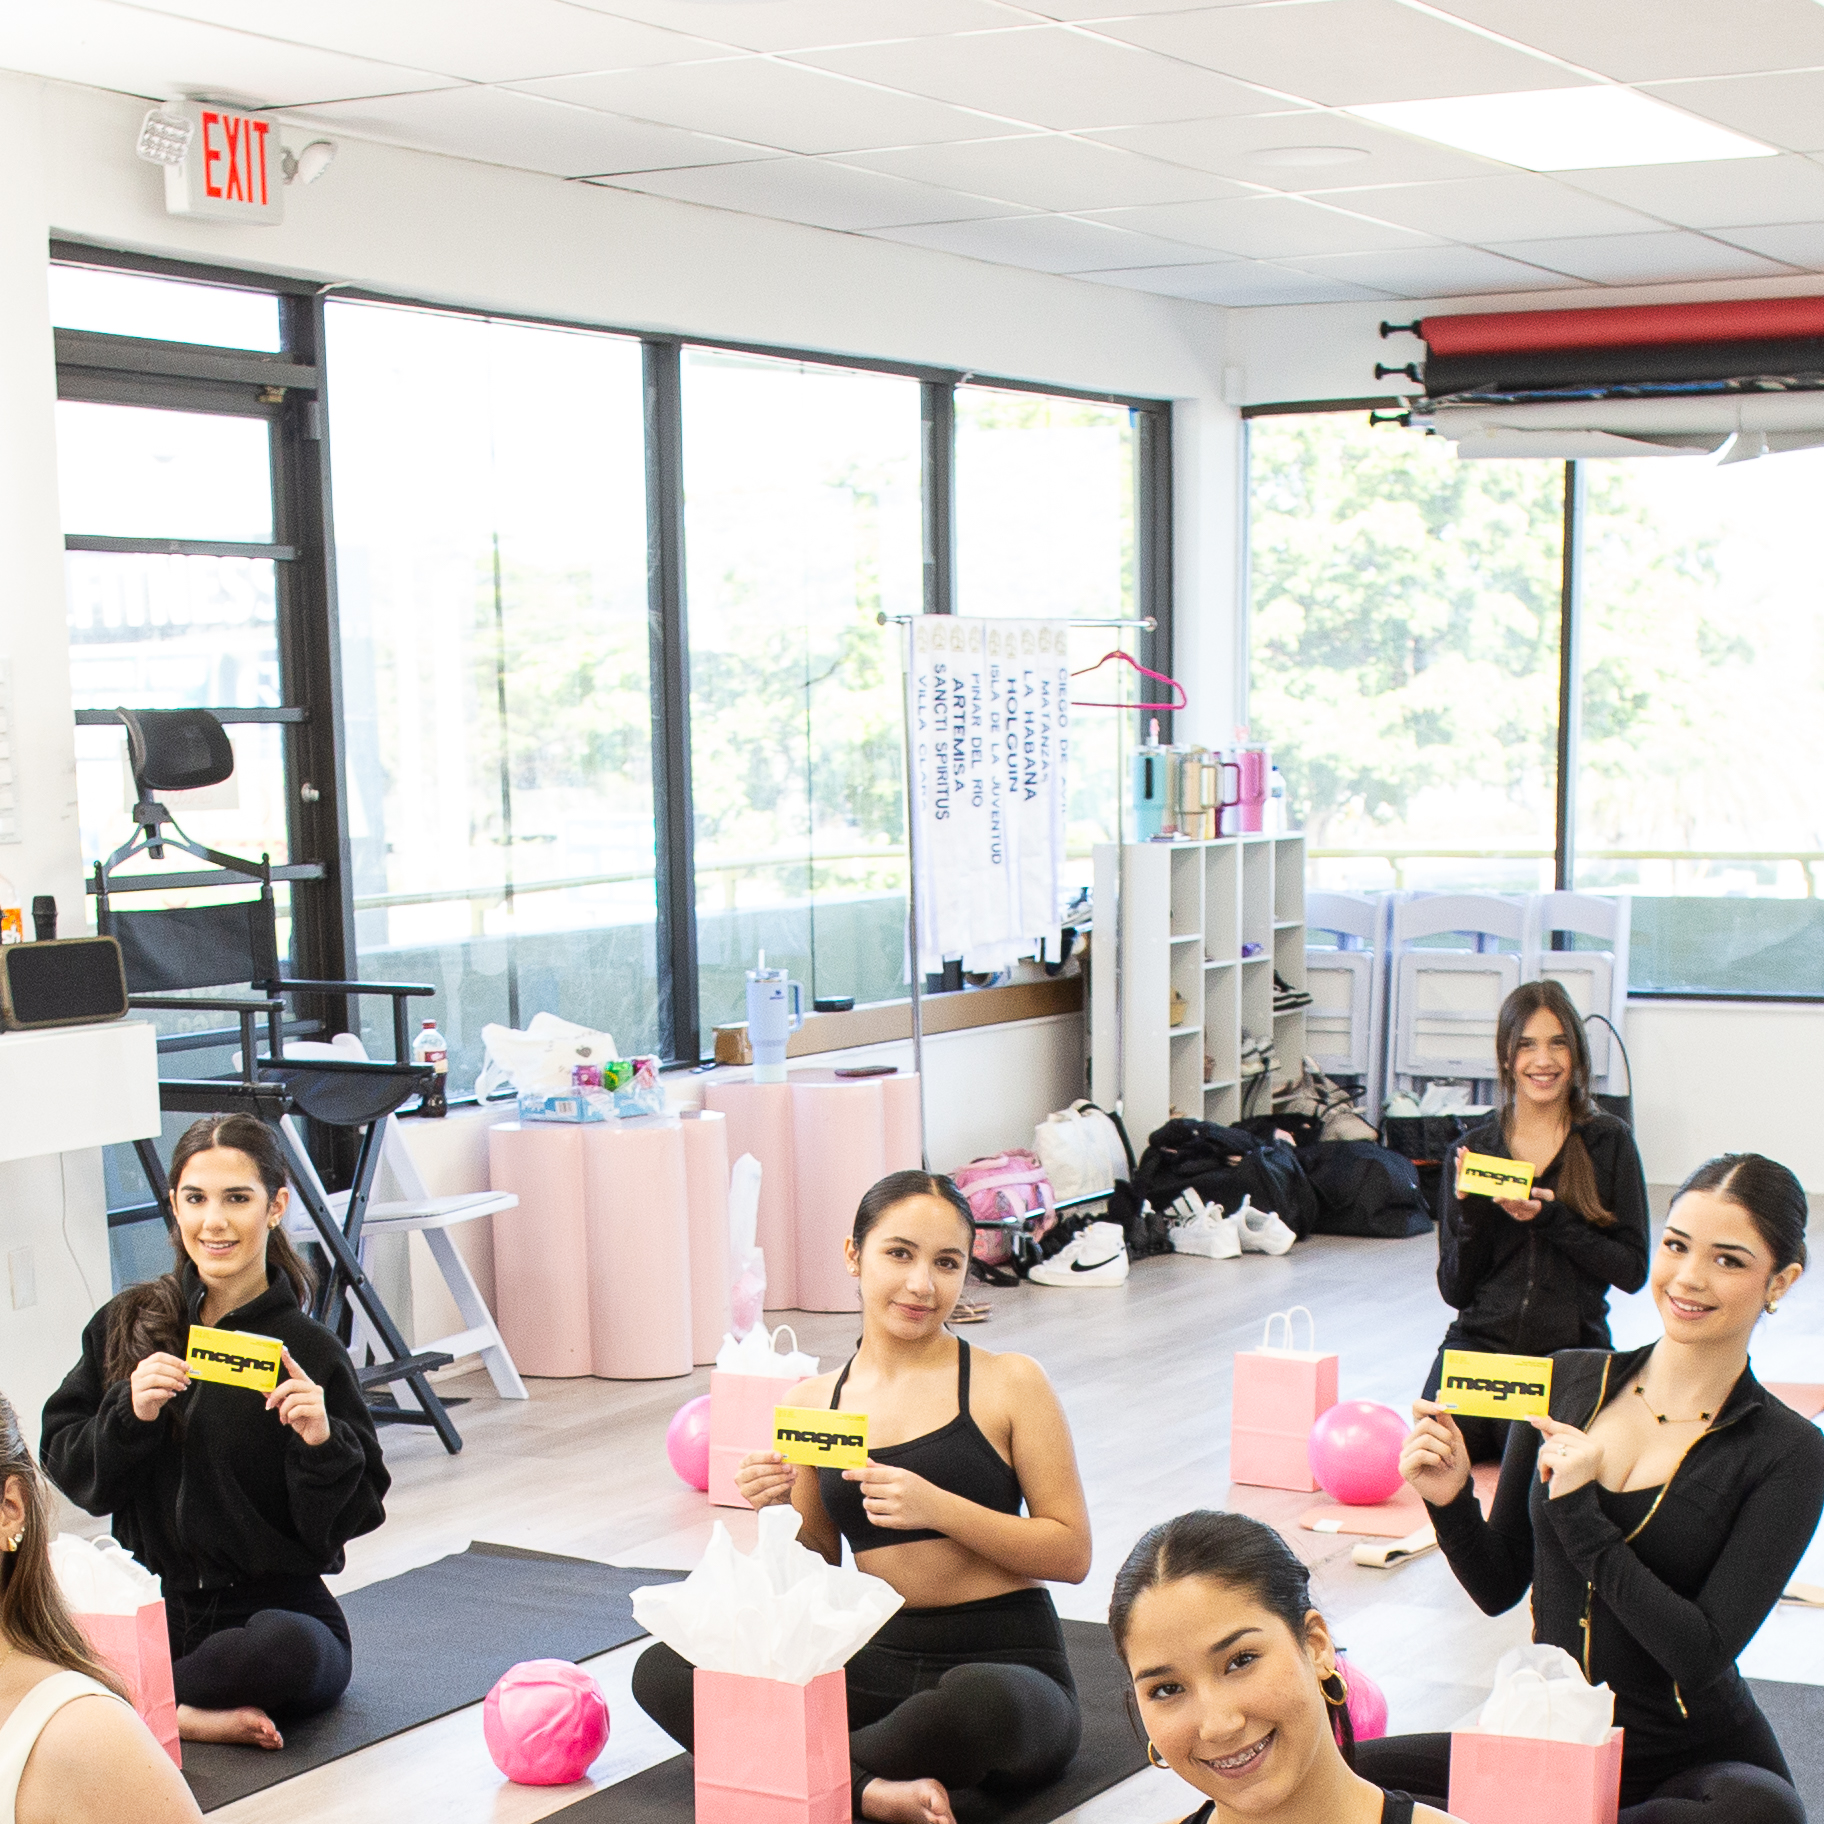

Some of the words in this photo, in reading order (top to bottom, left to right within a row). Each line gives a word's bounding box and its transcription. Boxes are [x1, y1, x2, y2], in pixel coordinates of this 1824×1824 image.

[202, 111, 269, 205] EXIT
[933, 663, 949, 732] SANCTI
[971, 673, 983, 727] PINAR
[990, 664, 1000, 702] ISLA
[1023, 669, 1034, 698] LA
[1058, 668, 1068, 728] CIEGO
[918, 675, 928, 731] VILLA
[990, 711, 1001, 733] DE
[952, 677, 965, 793] ARTEMISA
[971, 737, 983, 769] DEL
[991, 743, 1001, 765] LA
[1006, 678, 1018, 793] HOLGUIN
[1060, 739, 1068, 764] DE
[1023, 711, 1038, 802] HABANA
[934, 742, 950, 821] SPIRITUS
[971, 778, 984, 808] RIO
[990, 775, 1002, 865] JUVENTUD
[1465, 1168, 1528, 1185] magna
[191, 1347, 275, 1373] magna
[1446, 1376, 1545, 1401] magna
[777, 1429, 864, 1451] magna
